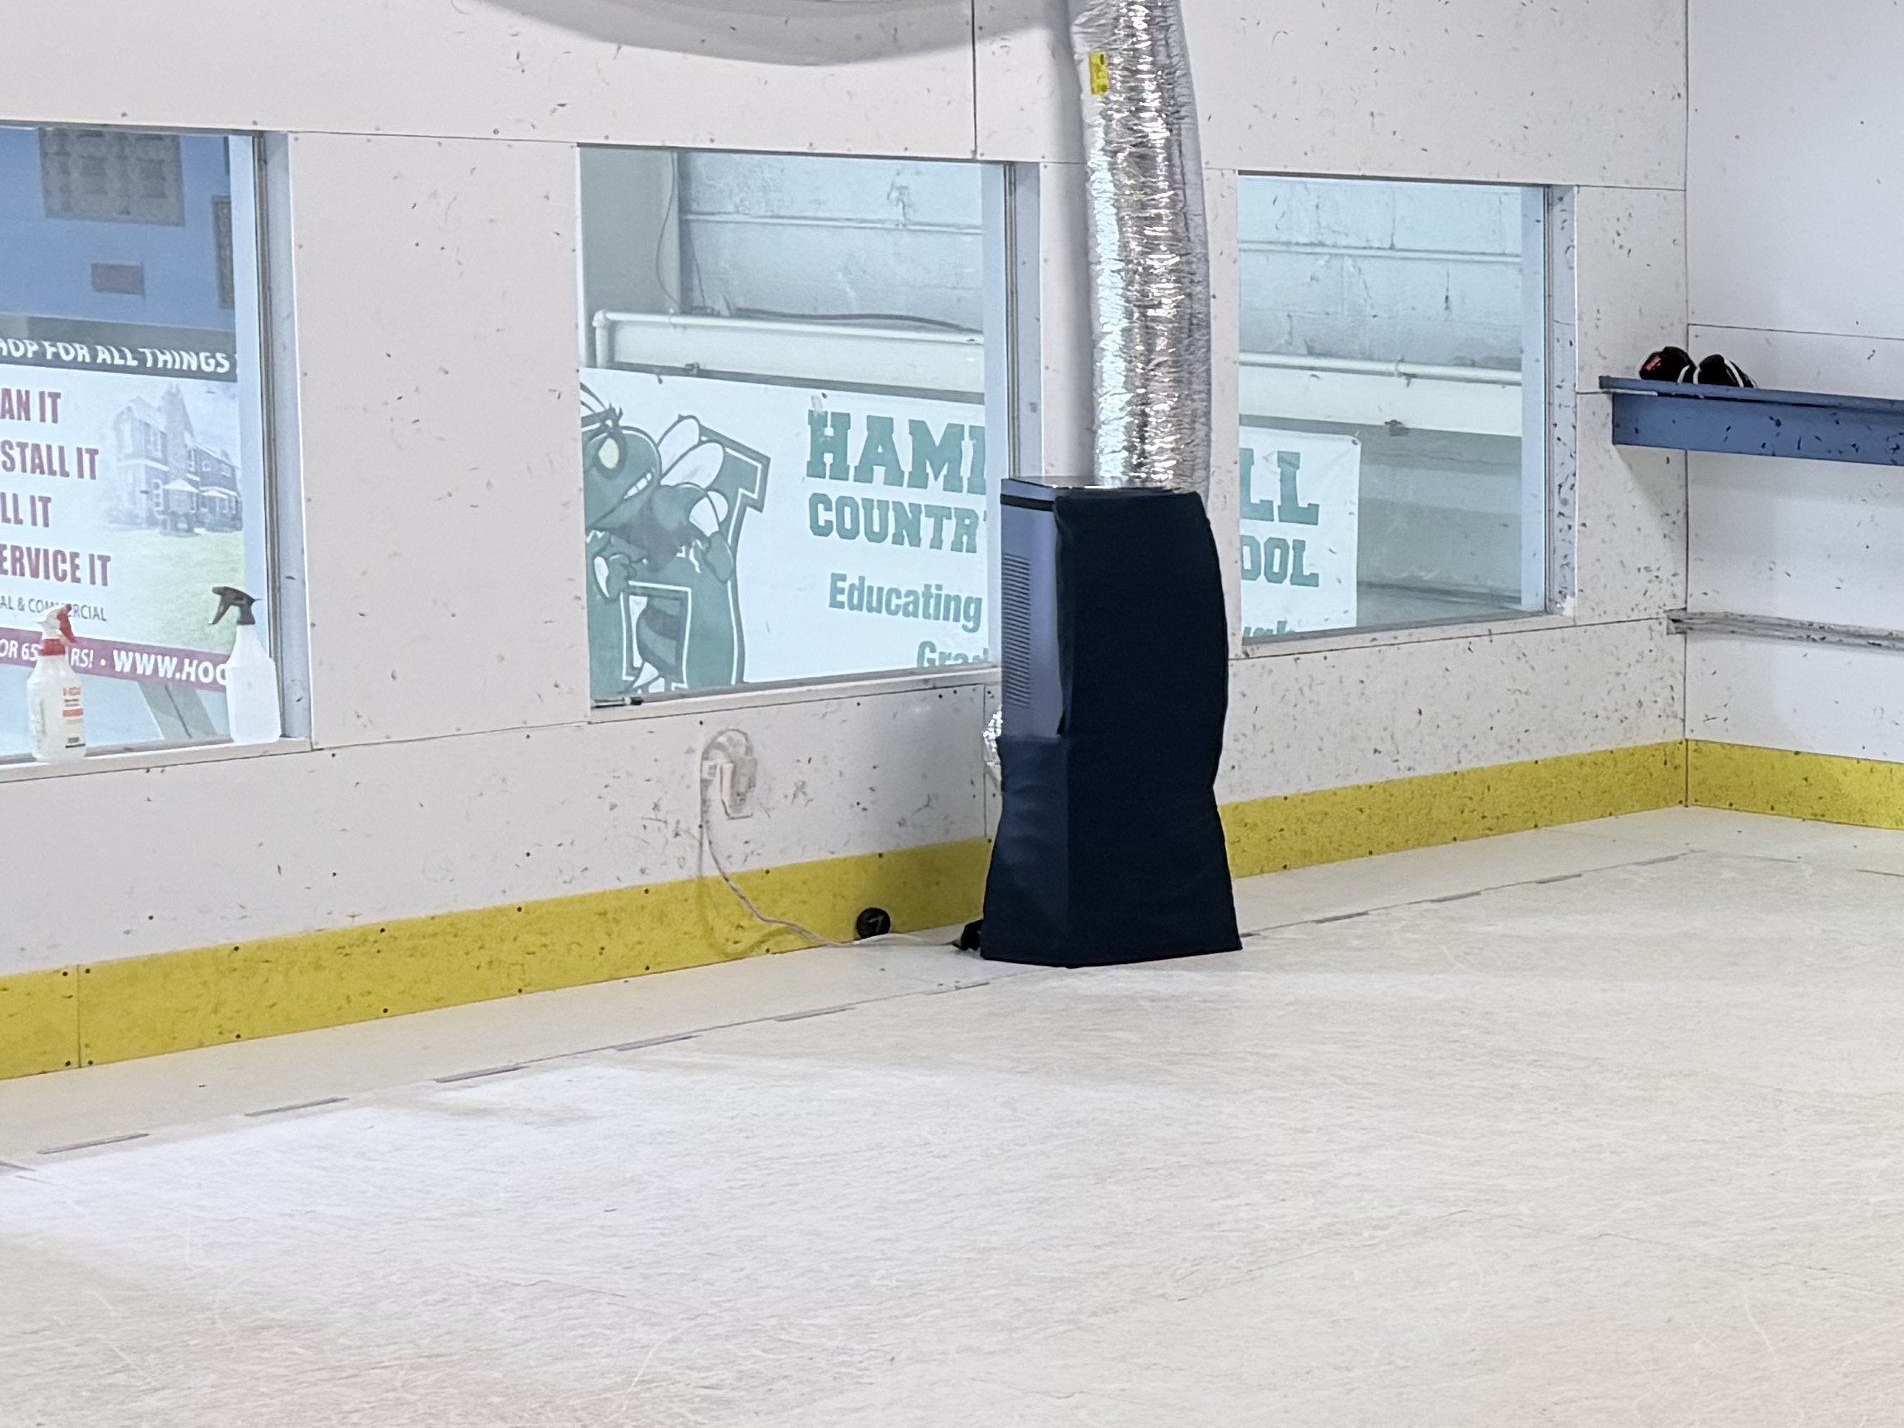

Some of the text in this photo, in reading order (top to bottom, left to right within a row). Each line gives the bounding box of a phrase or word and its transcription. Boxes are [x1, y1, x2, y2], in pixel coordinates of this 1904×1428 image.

[40, 341, 91, 363] FOR
[96, 345, 139, 367] ALL
[138, 348, 231, 373] THINGS
[39, 391, 62, 424] IT
[76, 447, 99, 480] IT
[30, 494, 52, 528] IT
[808, 493, 988, 554] COUNTR
[88, 553, 111, 587] IT
[17, 597, 26, 612] &
[28, 598, 107, 622] COMRCIAL
[828, 572, 983, 633] Educating
